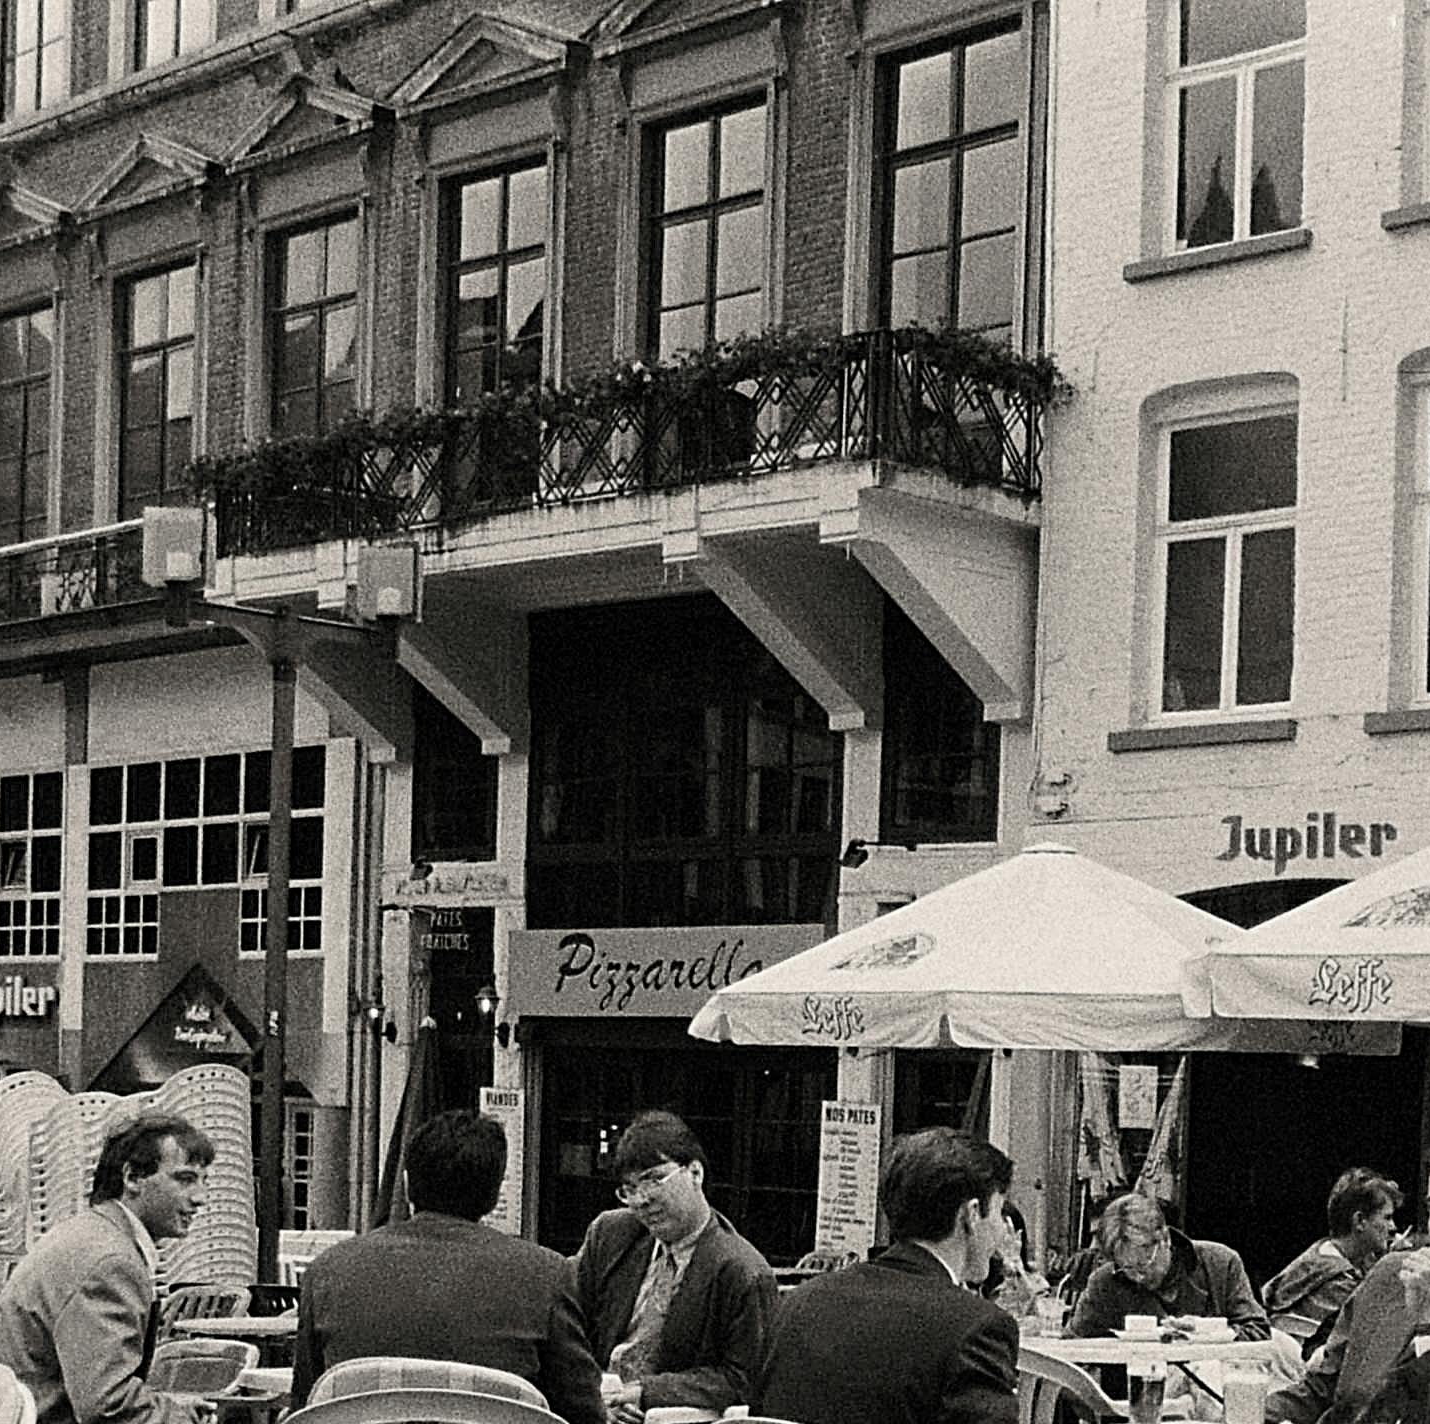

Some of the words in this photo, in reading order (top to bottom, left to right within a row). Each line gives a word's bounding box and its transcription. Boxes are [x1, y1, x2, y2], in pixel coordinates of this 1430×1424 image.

[1214, 811, 1398, 876] Jupiler
[1306, 957, 1394, 1014] Leffe
[801, 993, 866, 1041] Leffe
[825, 1107, 846, 1124] NOS
[847, 1108, 877, 1126] PATES
